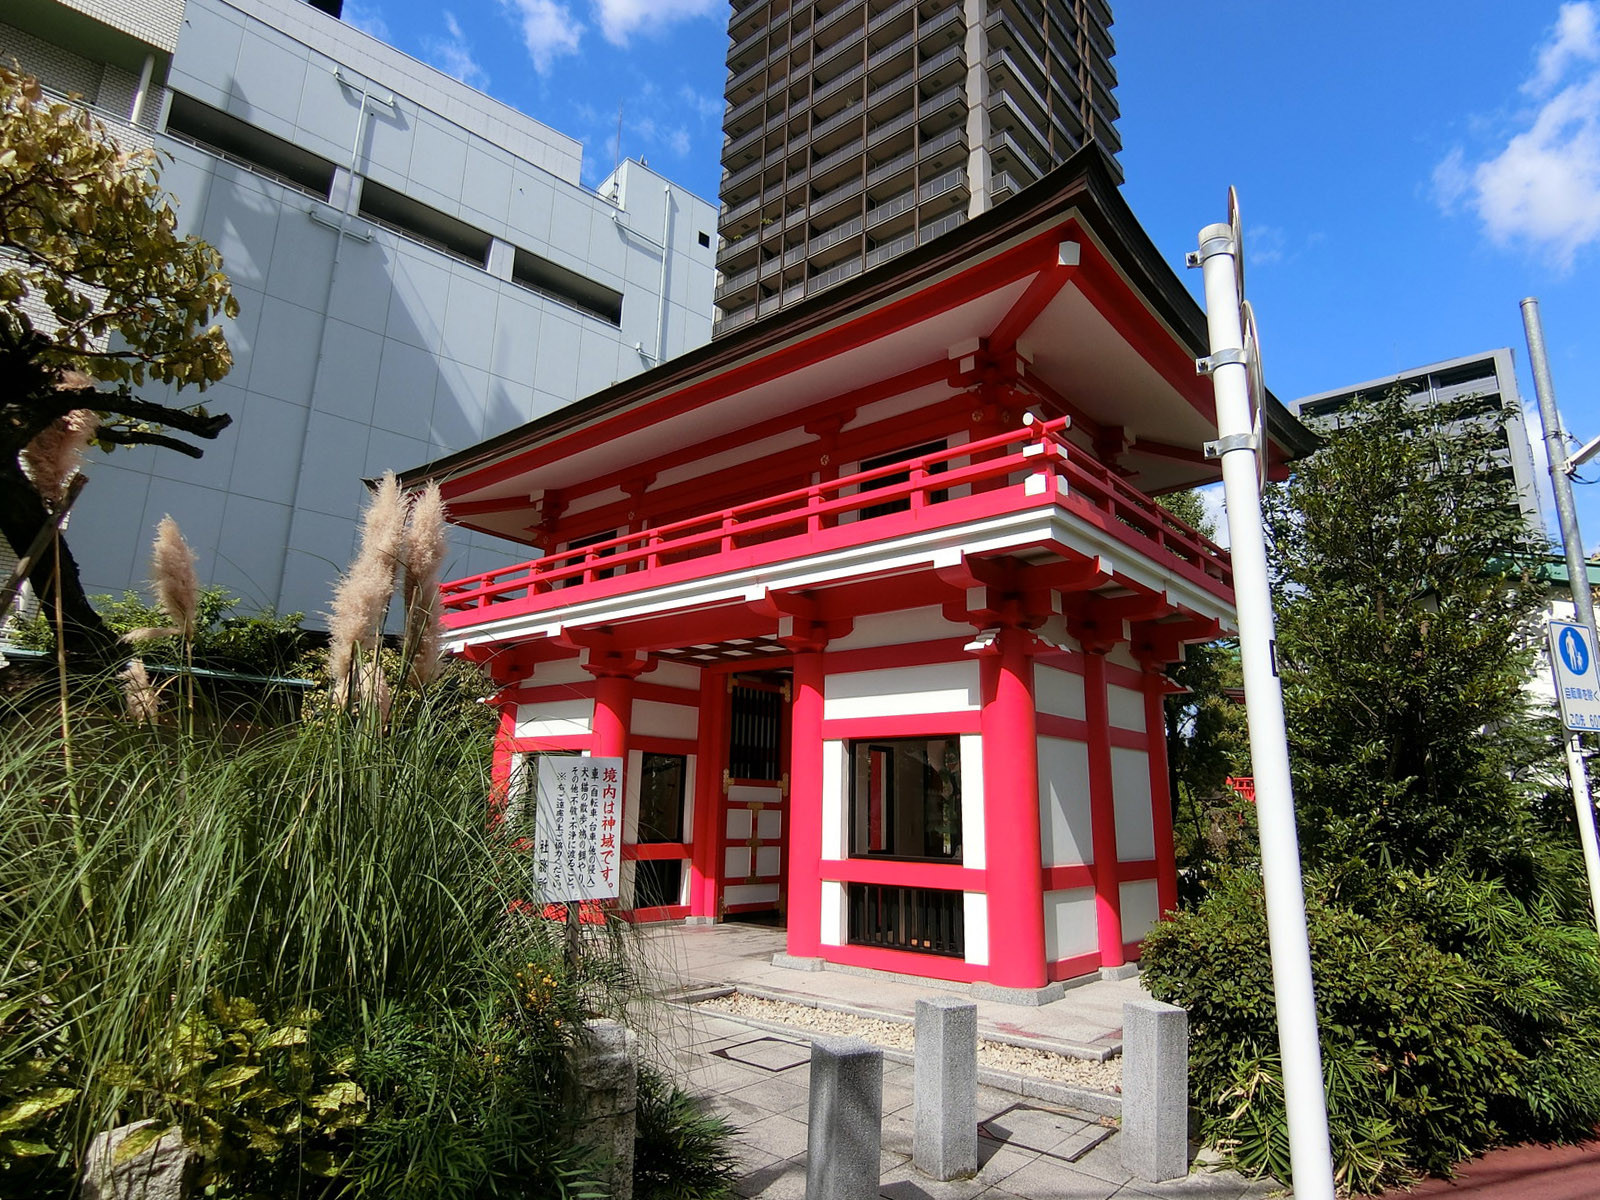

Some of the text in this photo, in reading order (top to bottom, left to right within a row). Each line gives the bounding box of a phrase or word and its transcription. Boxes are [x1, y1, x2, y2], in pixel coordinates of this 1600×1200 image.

[600, 767, 617, 888] 境内は神域です。
